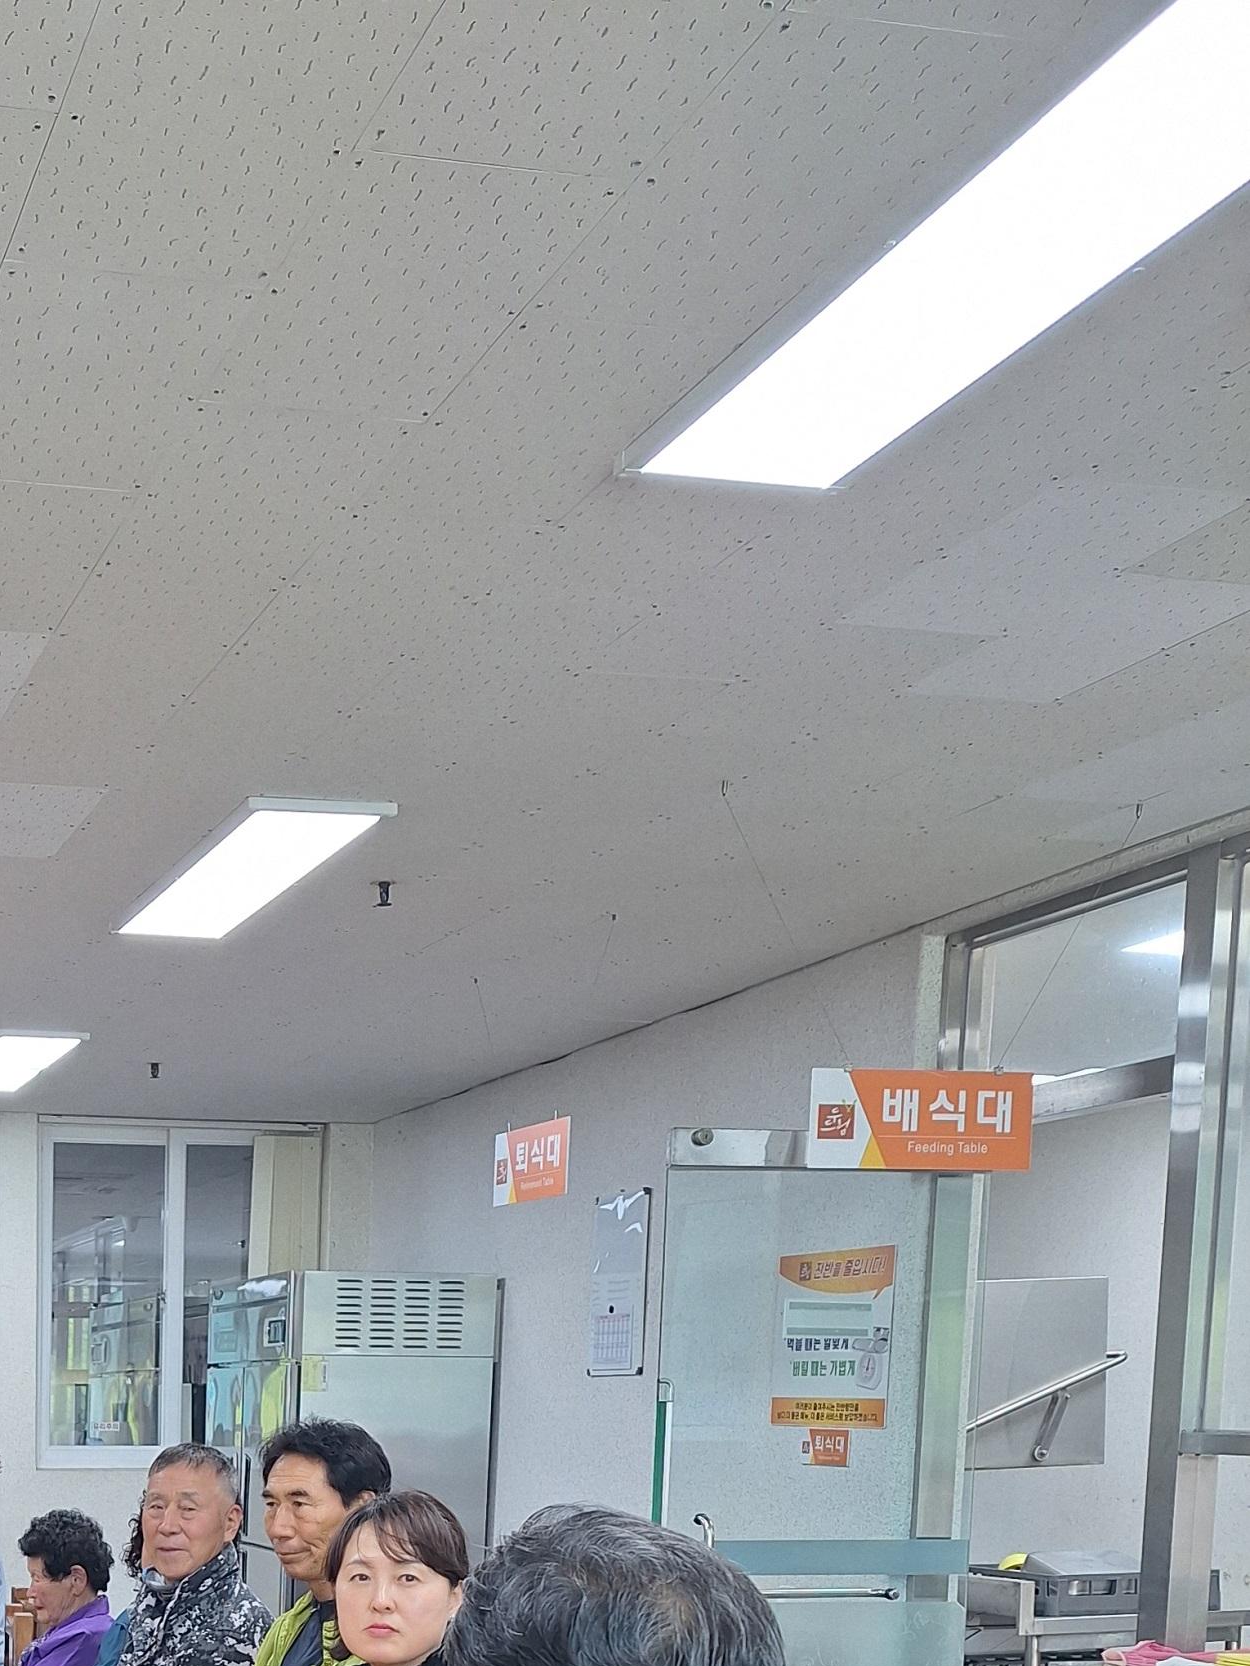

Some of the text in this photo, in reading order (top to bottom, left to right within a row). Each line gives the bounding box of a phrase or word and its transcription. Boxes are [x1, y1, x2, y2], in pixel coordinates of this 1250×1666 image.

[882, 1088, 1013, 1133] 배식대
[515, 1133, 561, 1174] 퇴식대
[907, 1140, 989, 1156] Feeding Table
[814, 1435, 845, 1453] 퇴식대
